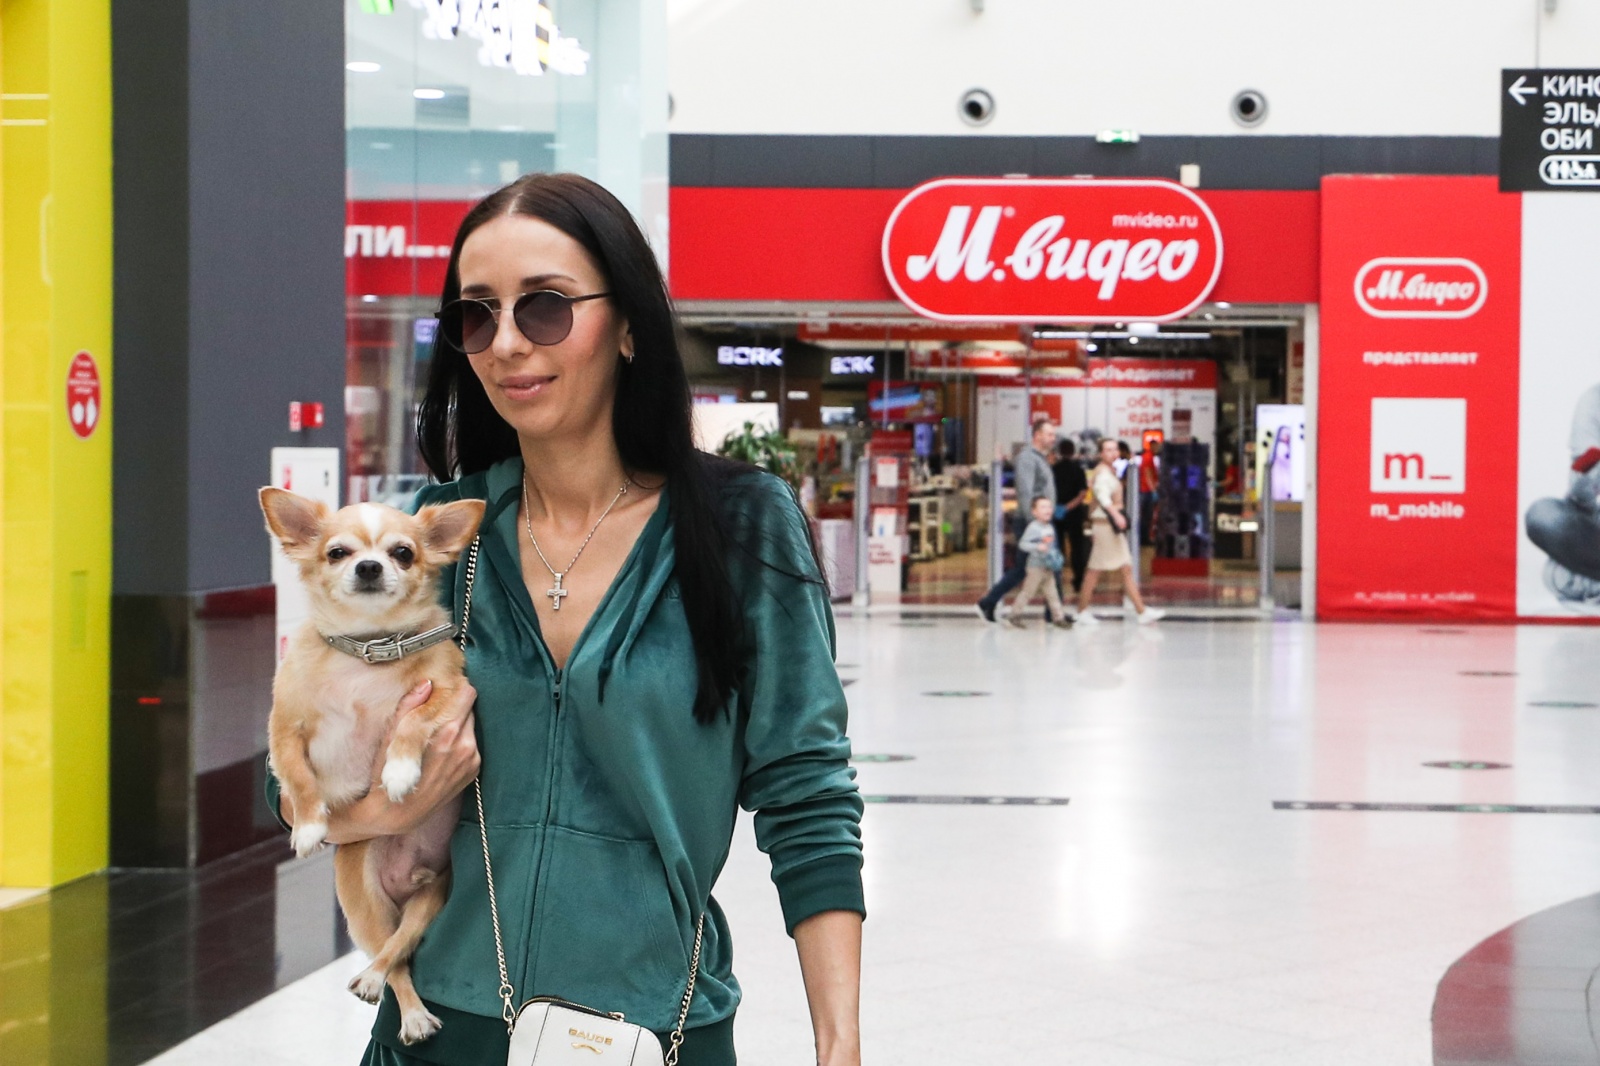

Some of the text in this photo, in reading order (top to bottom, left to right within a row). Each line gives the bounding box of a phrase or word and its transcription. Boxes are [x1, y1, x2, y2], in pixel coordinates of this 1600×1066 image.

[1540, 127, 1593, 151] ОБИ
[1112, 212, 1198, 229] mvideo.ru
[717, 345, 784, 367] BORK
[1362, 351, 1479, 367] представляет
[1369, 500, 1465, 521] m_mobile
